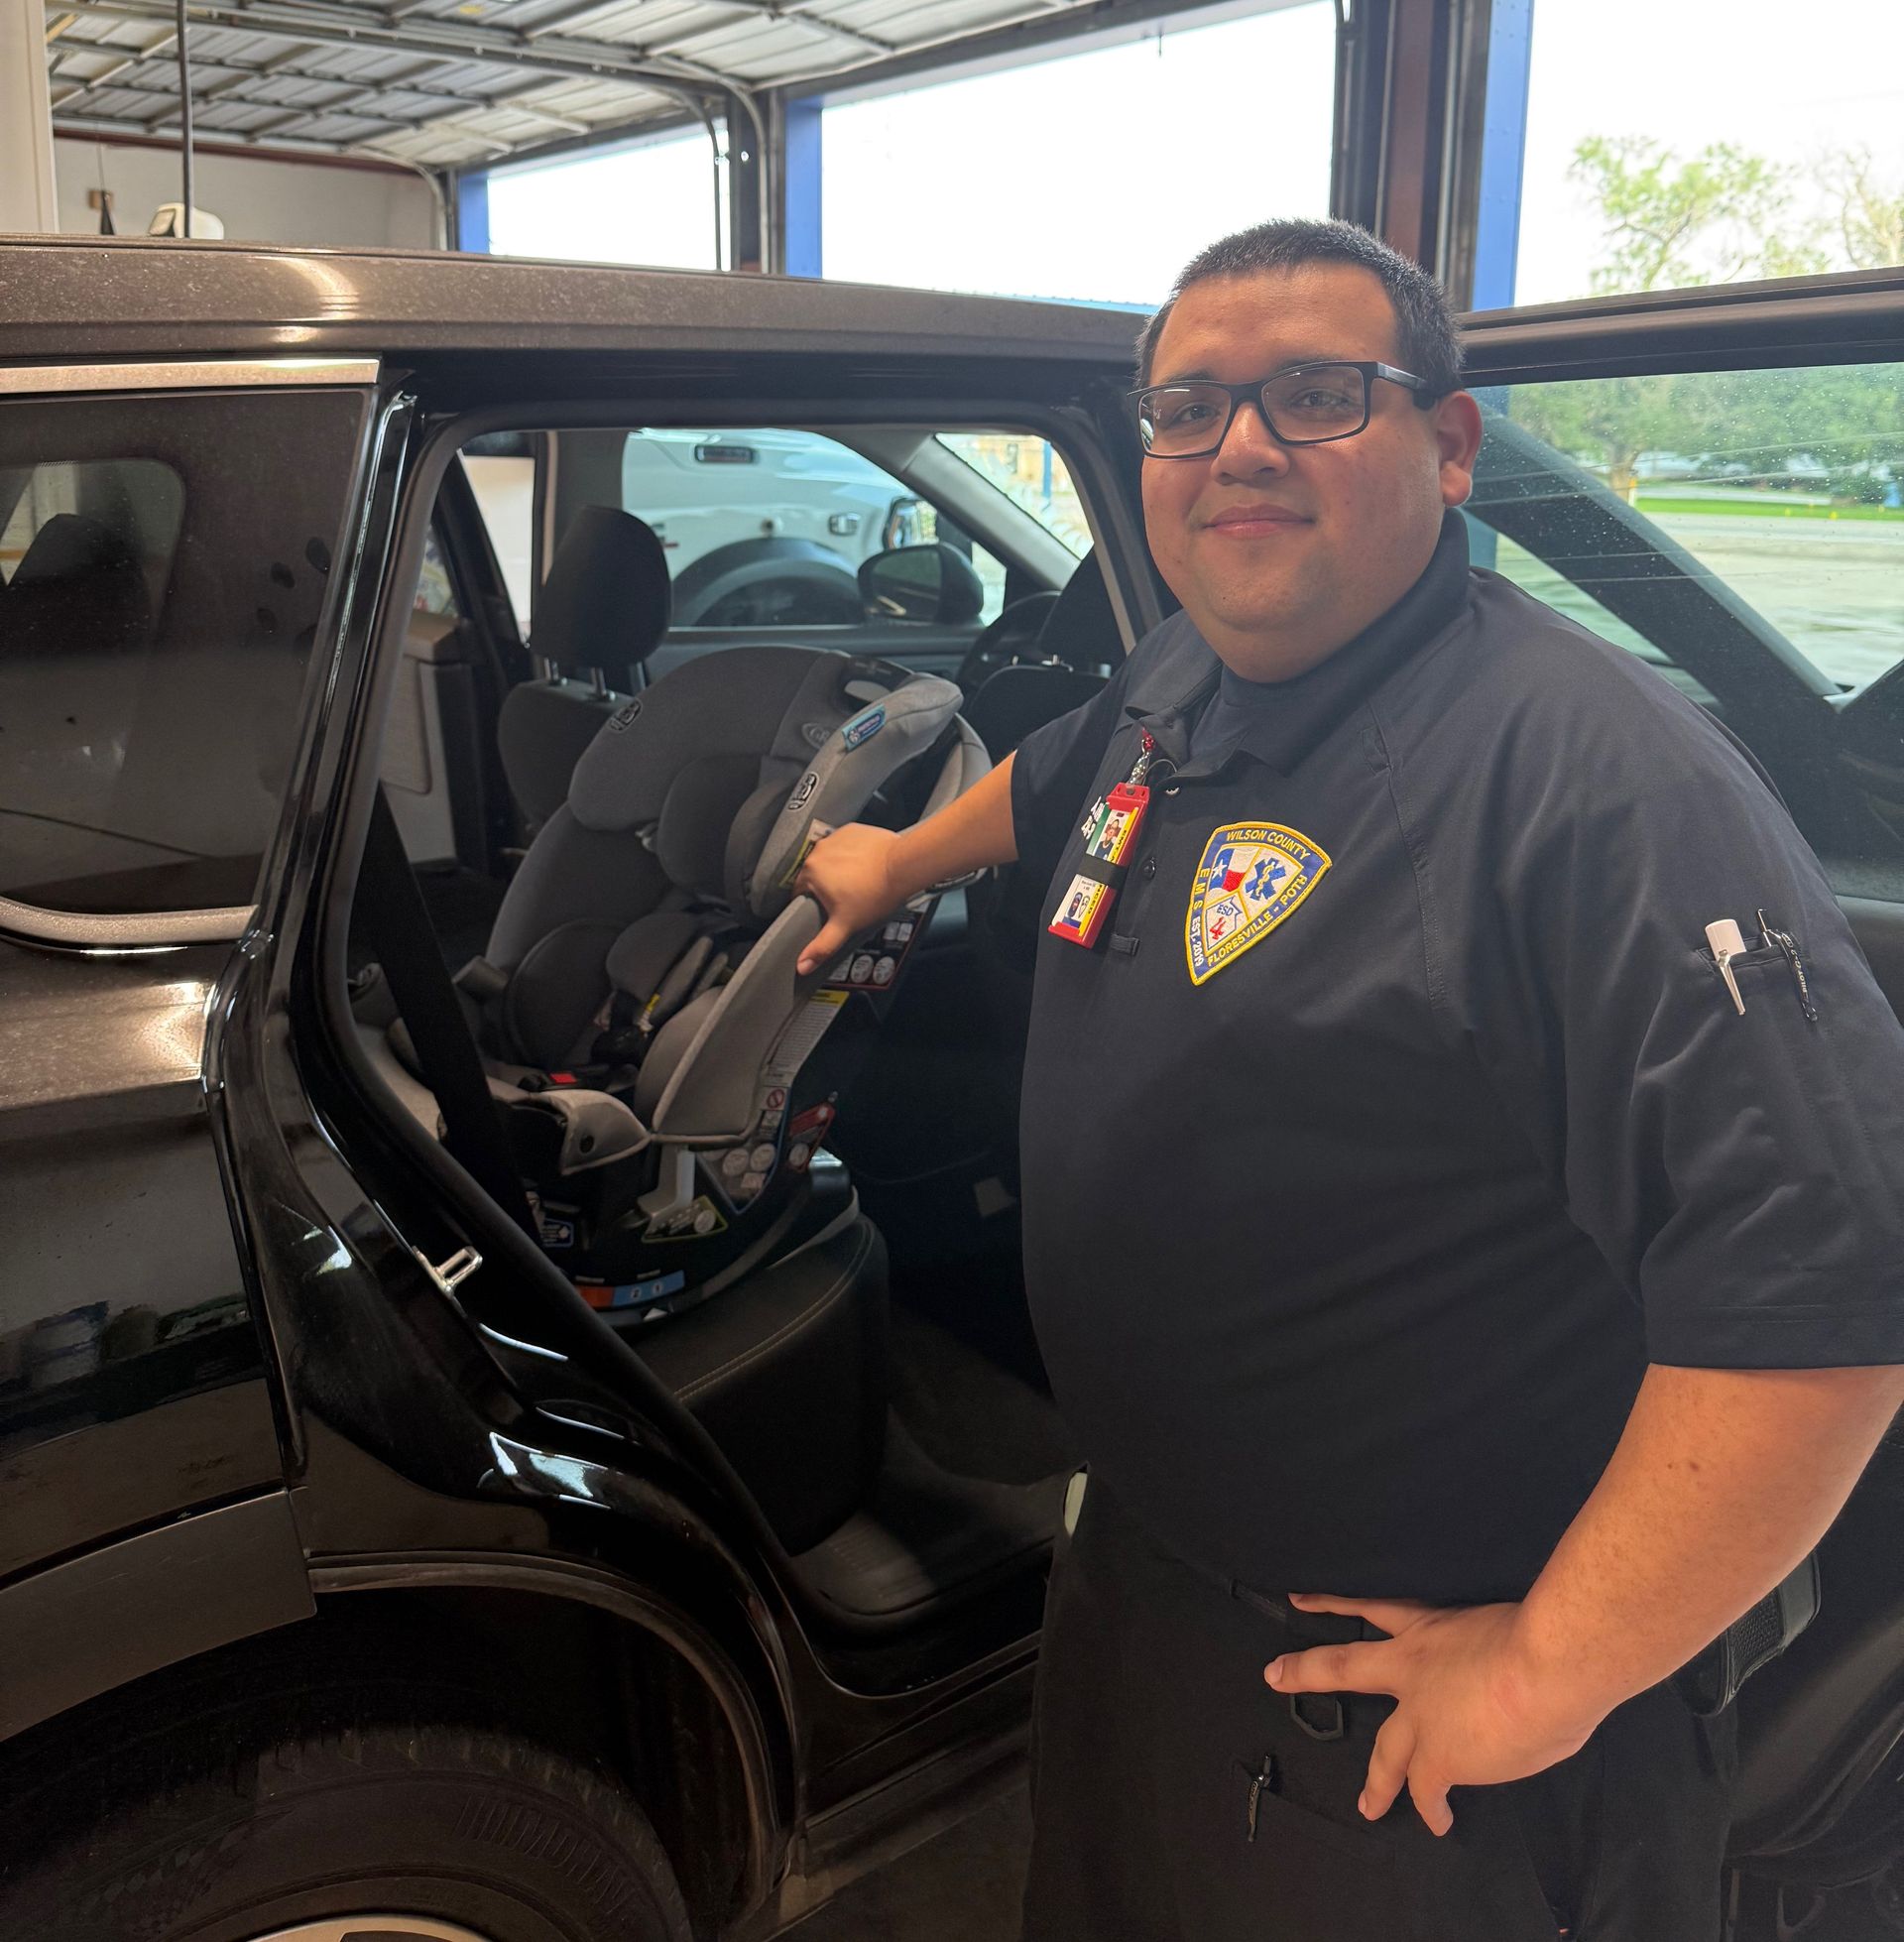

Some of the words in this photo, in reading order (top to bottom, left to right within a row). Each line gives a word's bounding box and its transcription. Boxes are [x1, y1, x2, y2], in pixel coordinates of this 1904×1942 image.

[1226, 830, 1265, 841] WILSON
[1266, 831, 1311, 860] COUNTY
[1193, 868, 1210, 910] EMS
[1207, 911, 1273, 967] FLORESVILLE
[1280, 873, 1308, 907] POTH
[1216, 904, 1234, 916] ESD
[1209, 916, 1226, 941] 4
[1191, 941, 1205, 966] 2019
